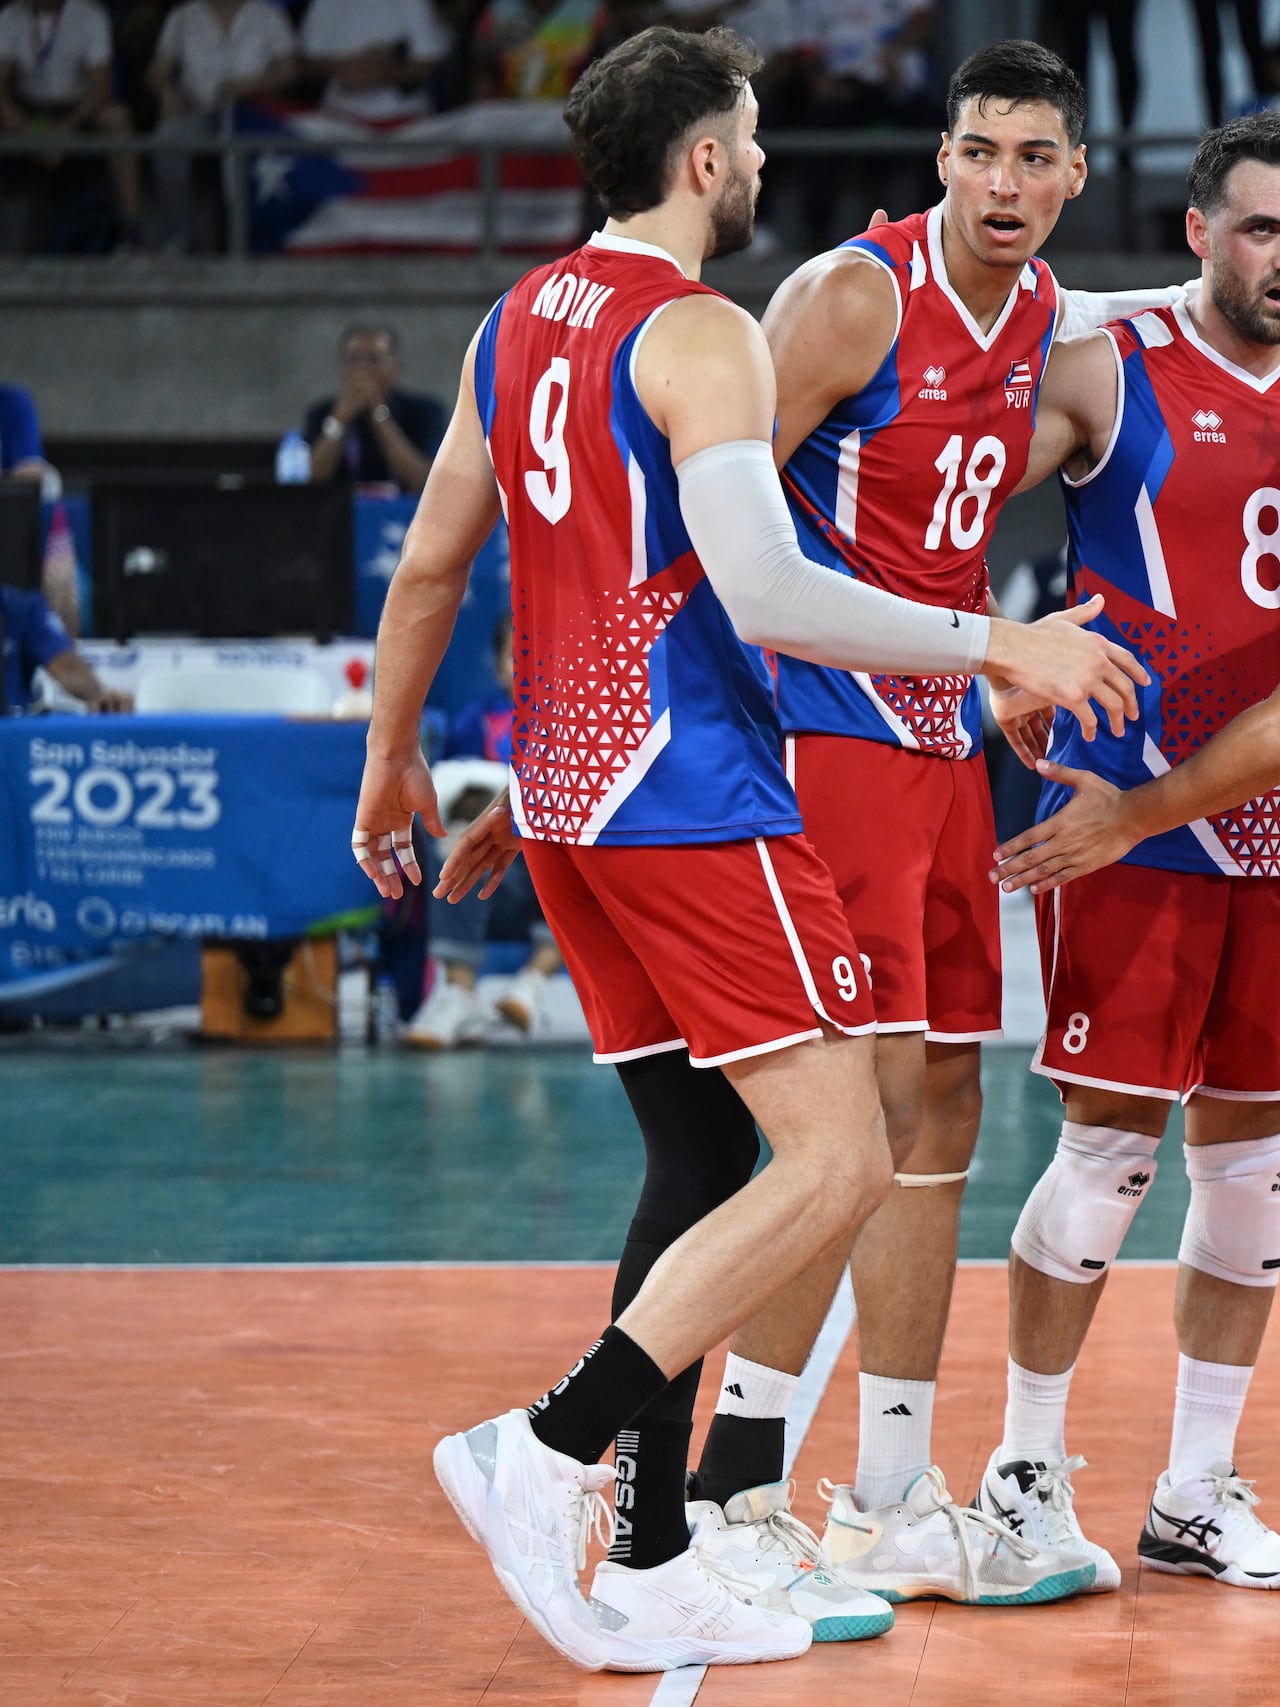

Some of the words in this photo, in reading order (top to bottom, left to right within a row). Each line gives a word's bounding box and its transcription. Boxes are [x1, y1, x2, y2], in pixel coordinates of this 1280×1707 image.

[1005, 390, 1030, 409] PUR
[524, 356, 572, 526] 9
[1193, 431, 1227, 444] errea
[924, 434, 1007, 551] 18
[29, 738, 84, 764] San
[90, 740, 218, 766] Salvador
[29, 766, 222, 830] 2023
[831, 955, 858, 1002] 9
[1062, 1011, 1091, 1055] 8
